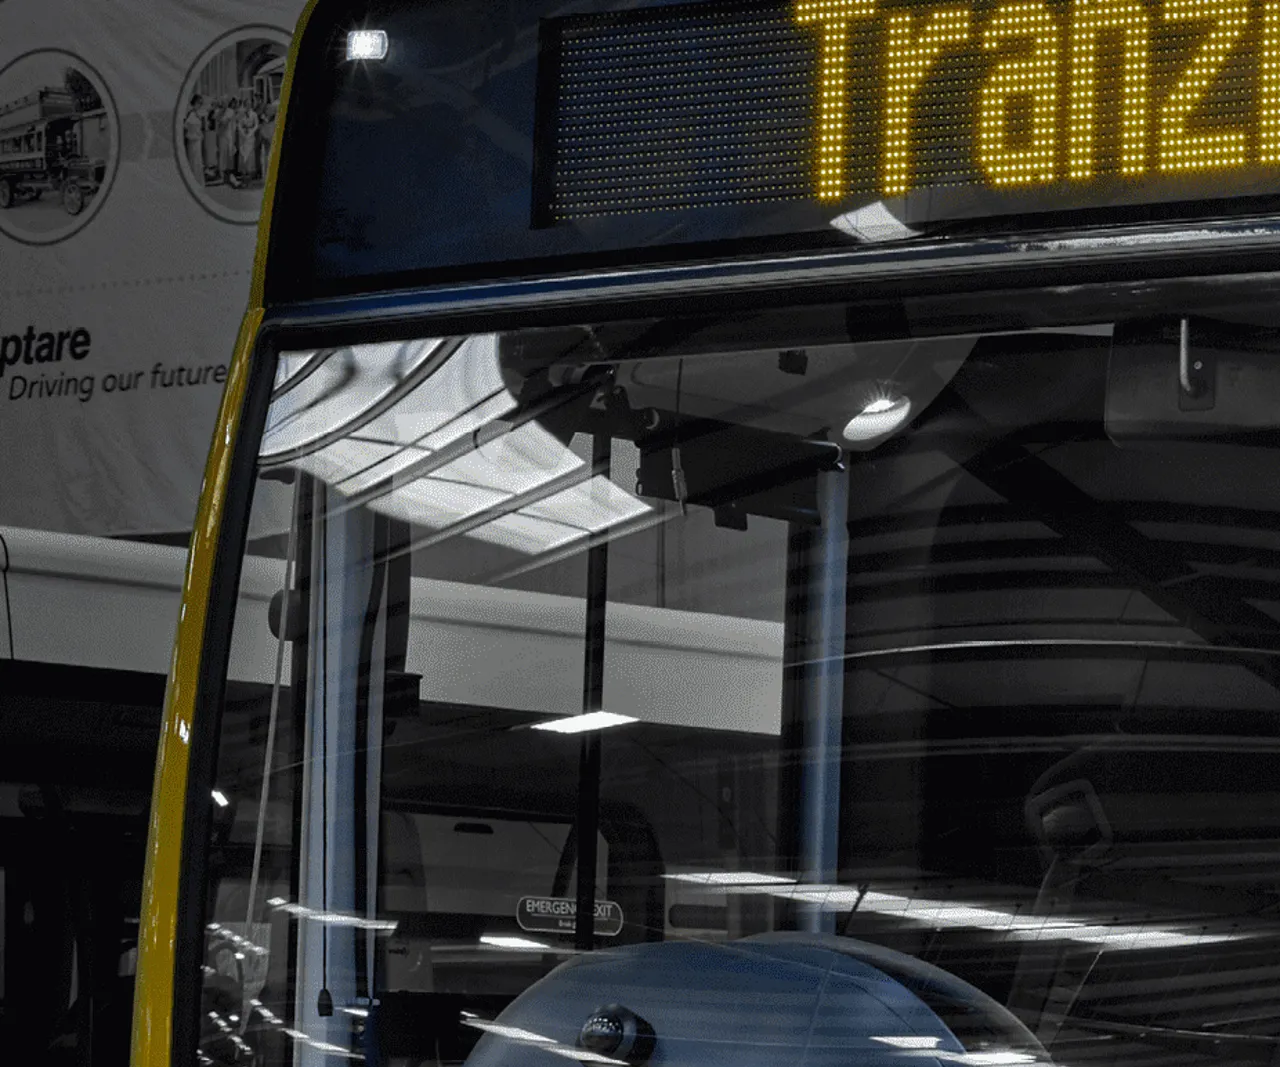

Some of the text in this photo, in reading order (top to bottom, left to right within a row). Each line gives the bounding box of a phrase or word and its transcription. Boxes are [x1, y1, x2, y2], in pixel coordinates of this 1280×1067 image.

[0, 326, 90, 377] ptare
[9, 362, 227, 402] Driving our future
[526, 899, 577, 914] EMERGEN
